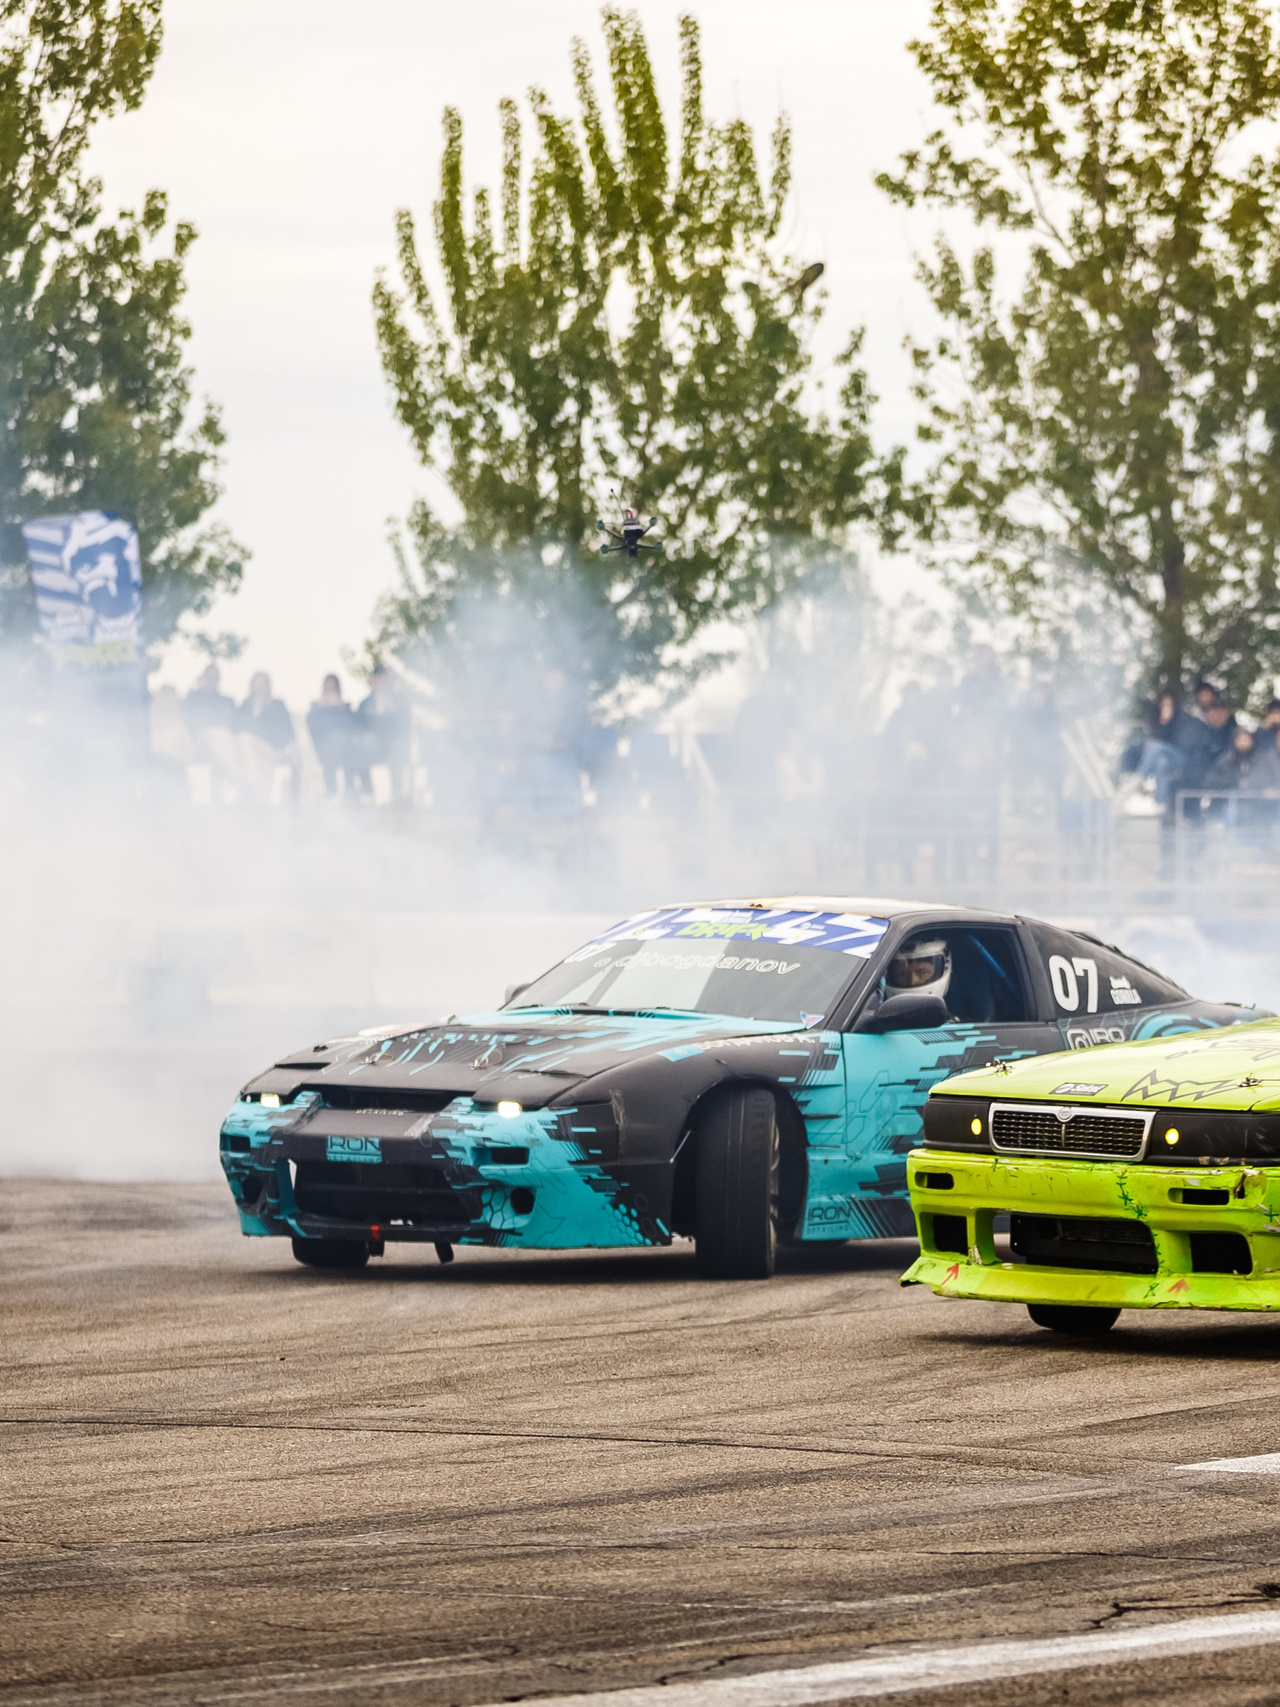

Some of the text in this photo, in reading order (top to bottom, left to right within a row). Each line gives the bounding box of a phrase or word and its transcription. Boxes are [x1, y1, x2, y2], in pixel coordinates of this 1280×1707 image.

[1049, 955, 1098, 1013] 07
[327, 1135, 380, 1151] IRON
[808, 1206, 851, 1221] IRON
